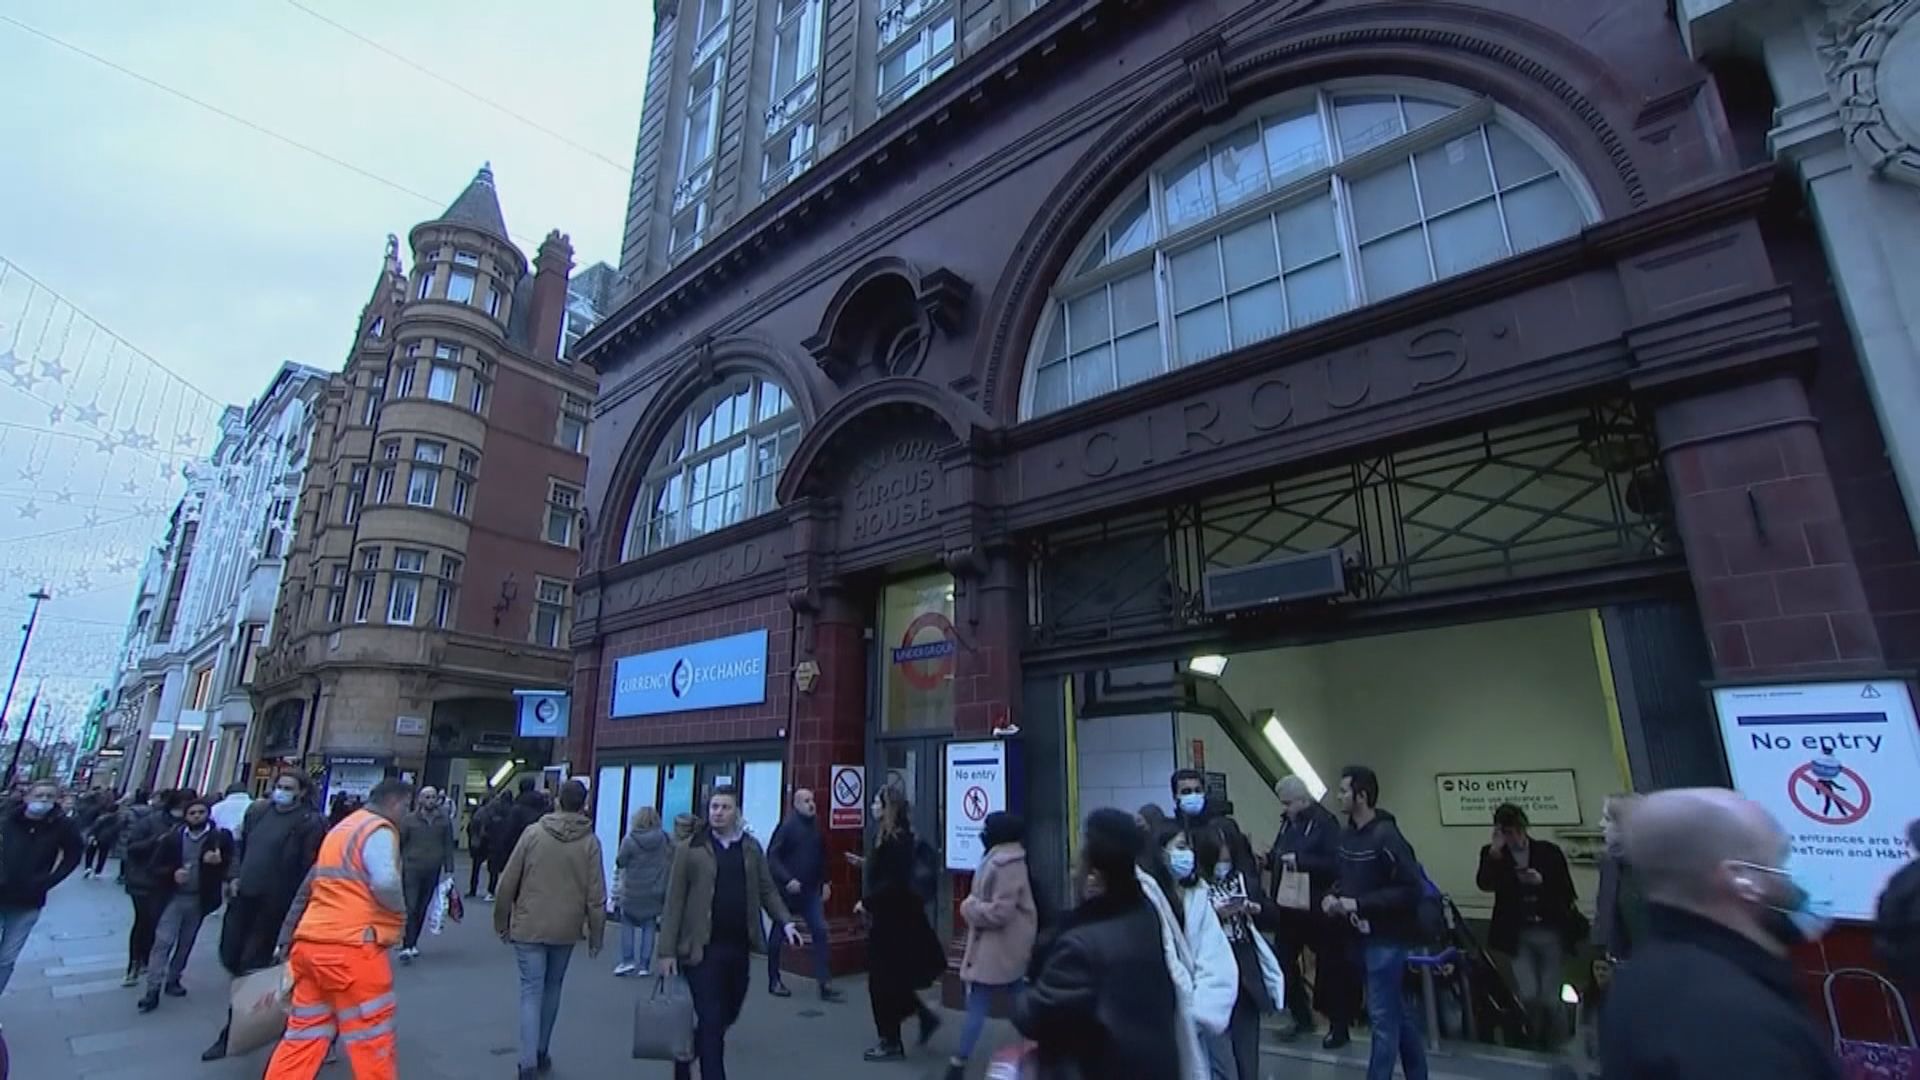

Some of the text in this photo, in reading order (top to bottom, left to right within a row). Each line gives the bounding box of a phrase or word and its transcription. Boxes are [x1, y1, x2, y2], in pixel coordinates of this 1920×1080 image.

[1082, 327, 1467, 477] CIRCUS
[856, 469, 933, 511] CIRCUS
[854, 498, 933, 540] HOUSE
[629, 543, 762, 607] OXFORD
[619, 672, 669, 693] CURRENCY
[694, 658, 760, 683] EXCHANGE
[1751, 732, 1882, 753] No entry
[956, 769, 997, 781] No entry
[1458, 777, 1528, 792] No entry
[1800, 834, 1864, 844] entrances
[1869, 837, 1889, 846] are
[1848, 847, 1872, 857] and
[1876, 848, 1911, 859] H&M
